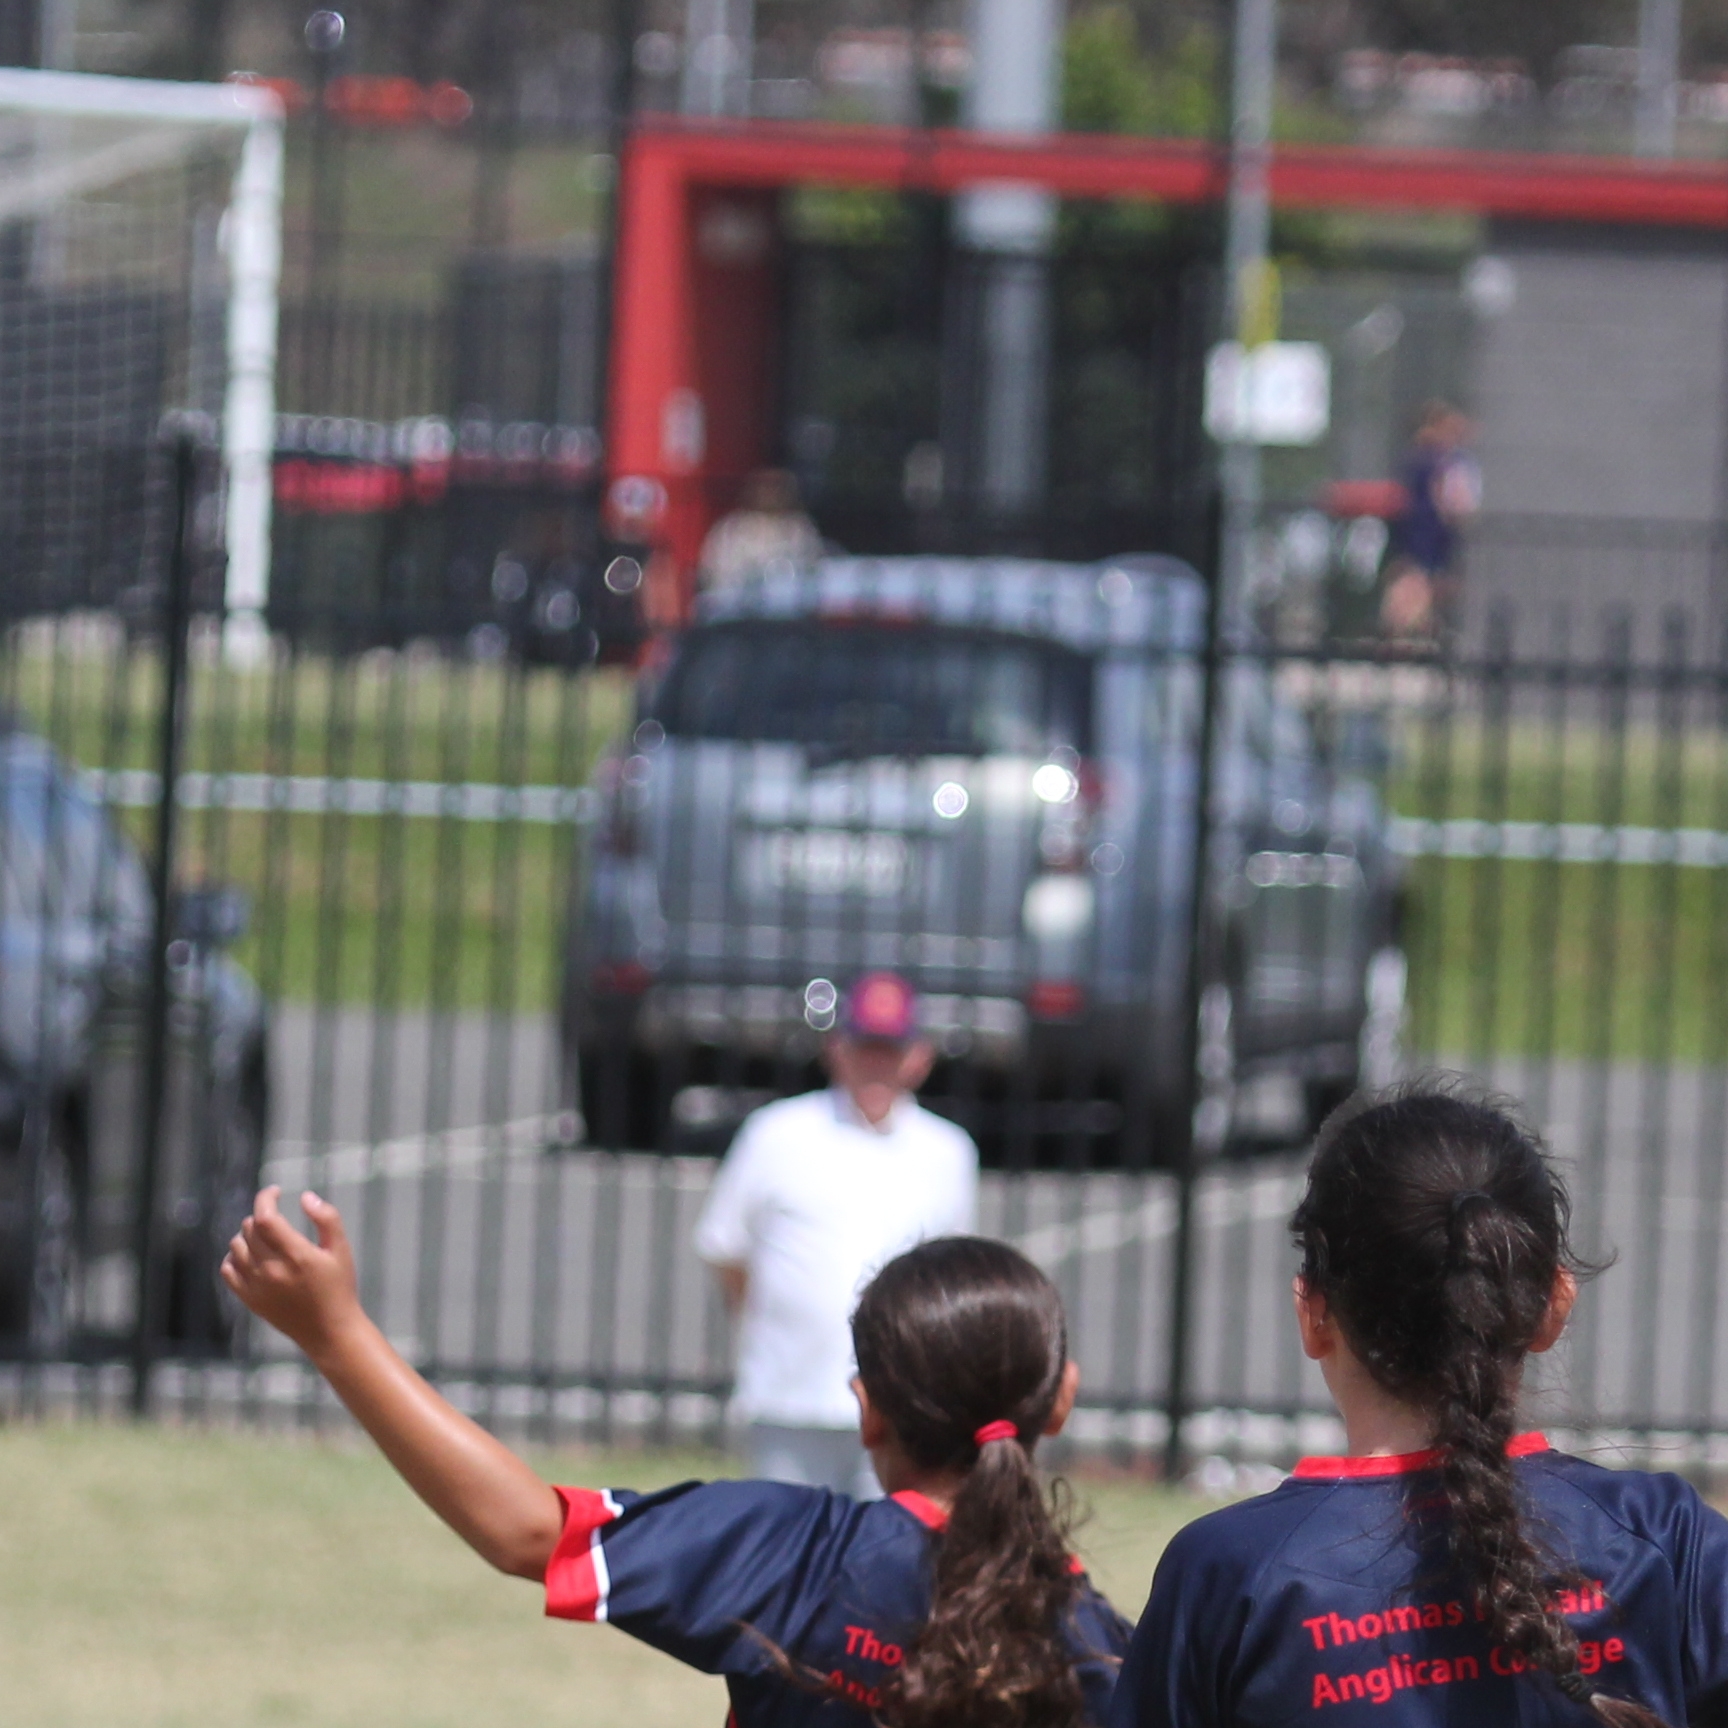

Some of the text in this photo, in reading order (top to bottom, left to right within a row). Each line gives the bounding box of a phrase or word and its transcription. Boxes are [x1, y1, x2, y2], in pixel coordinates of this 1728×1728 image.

[844, 1625, 903, 1667] Tho
[1302, 1600, 1465, 1650] Thomas
[1312, 1636, 1625, 1709] Anglican Coge
